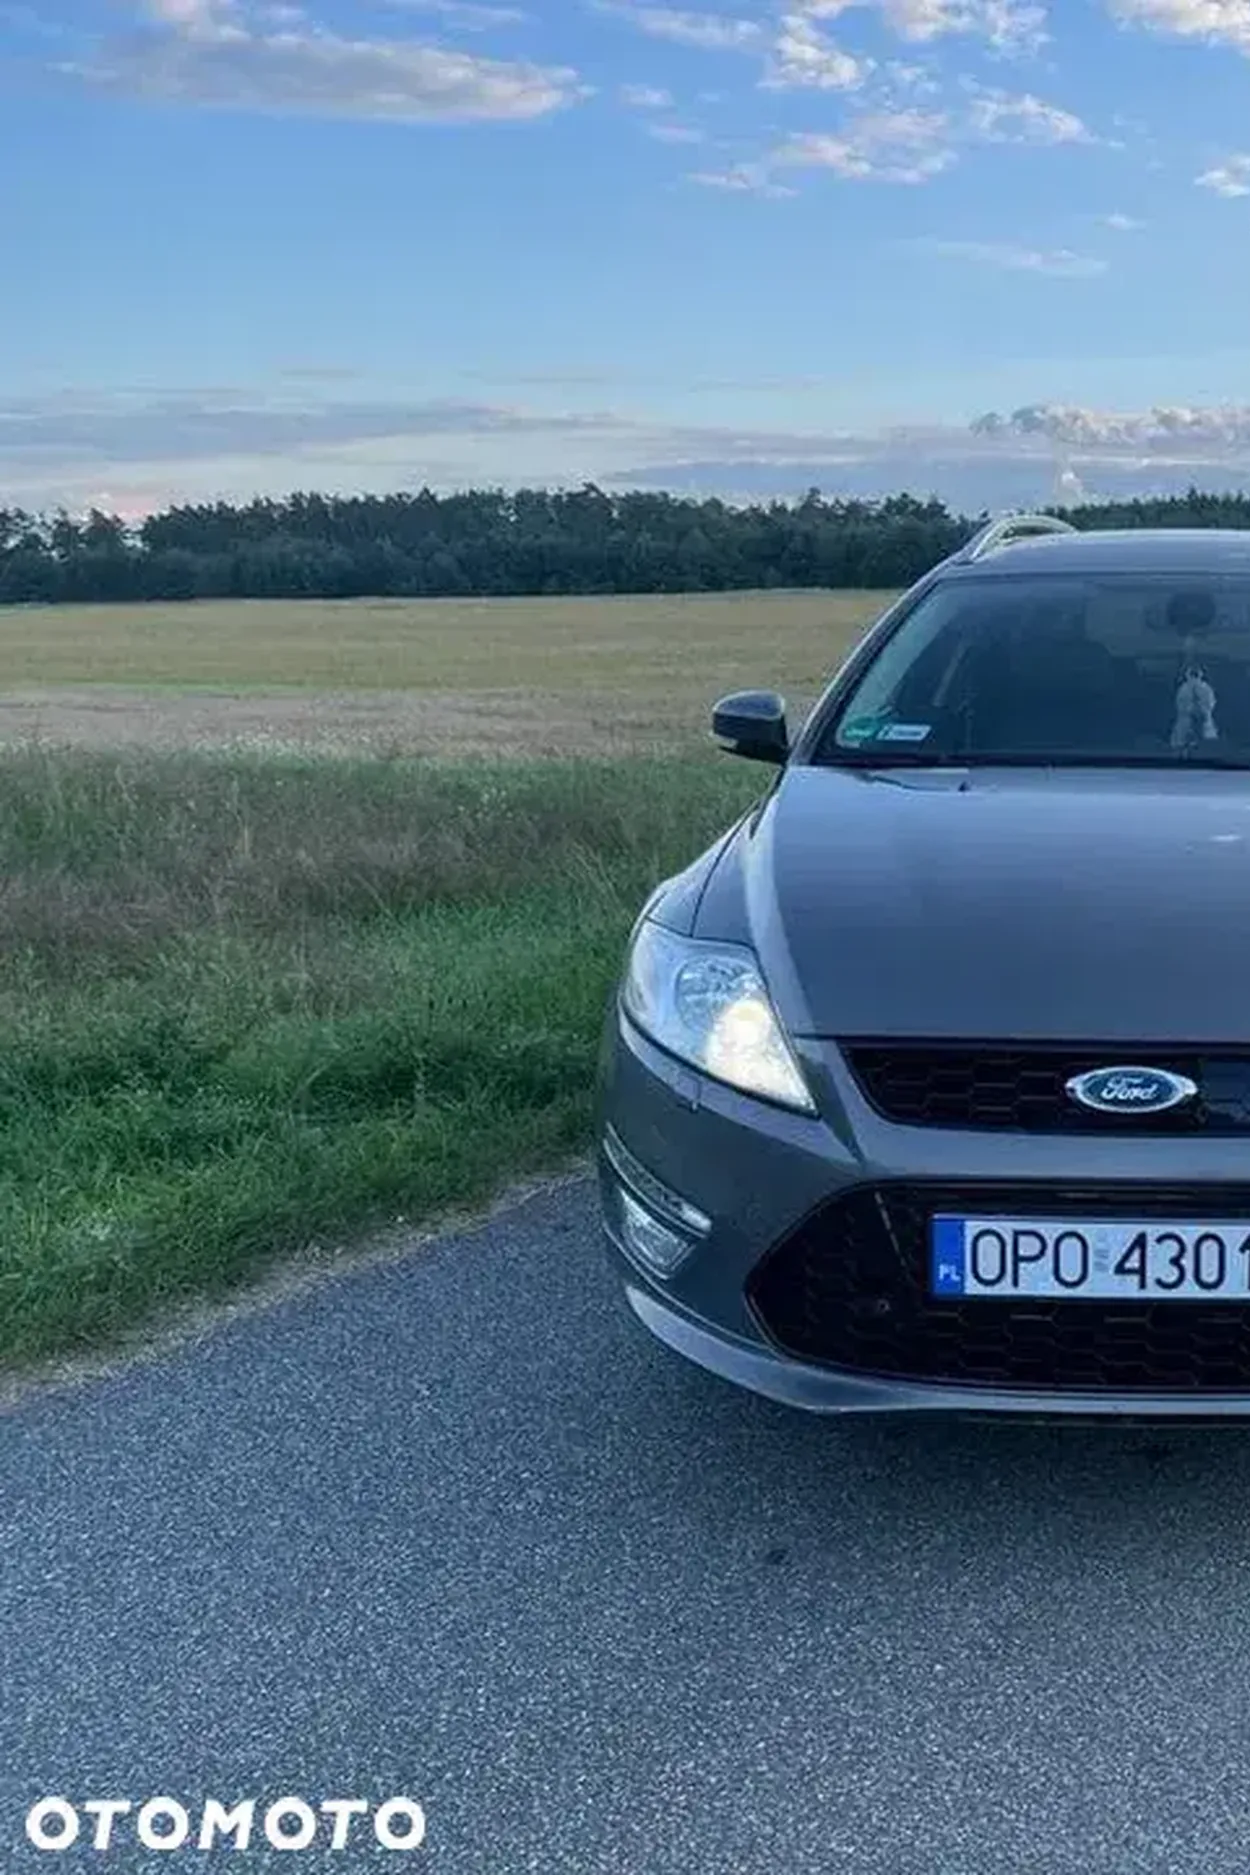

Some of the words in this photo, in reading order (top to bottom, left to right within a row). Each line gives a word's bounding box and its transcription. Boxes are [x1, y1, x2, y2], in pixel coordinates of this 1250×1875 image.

[1101, 1076, 1158, 1100] Ford
[971, 1228, 1089, 1288] OPO
[938, 1265, 961, 1282] PL
